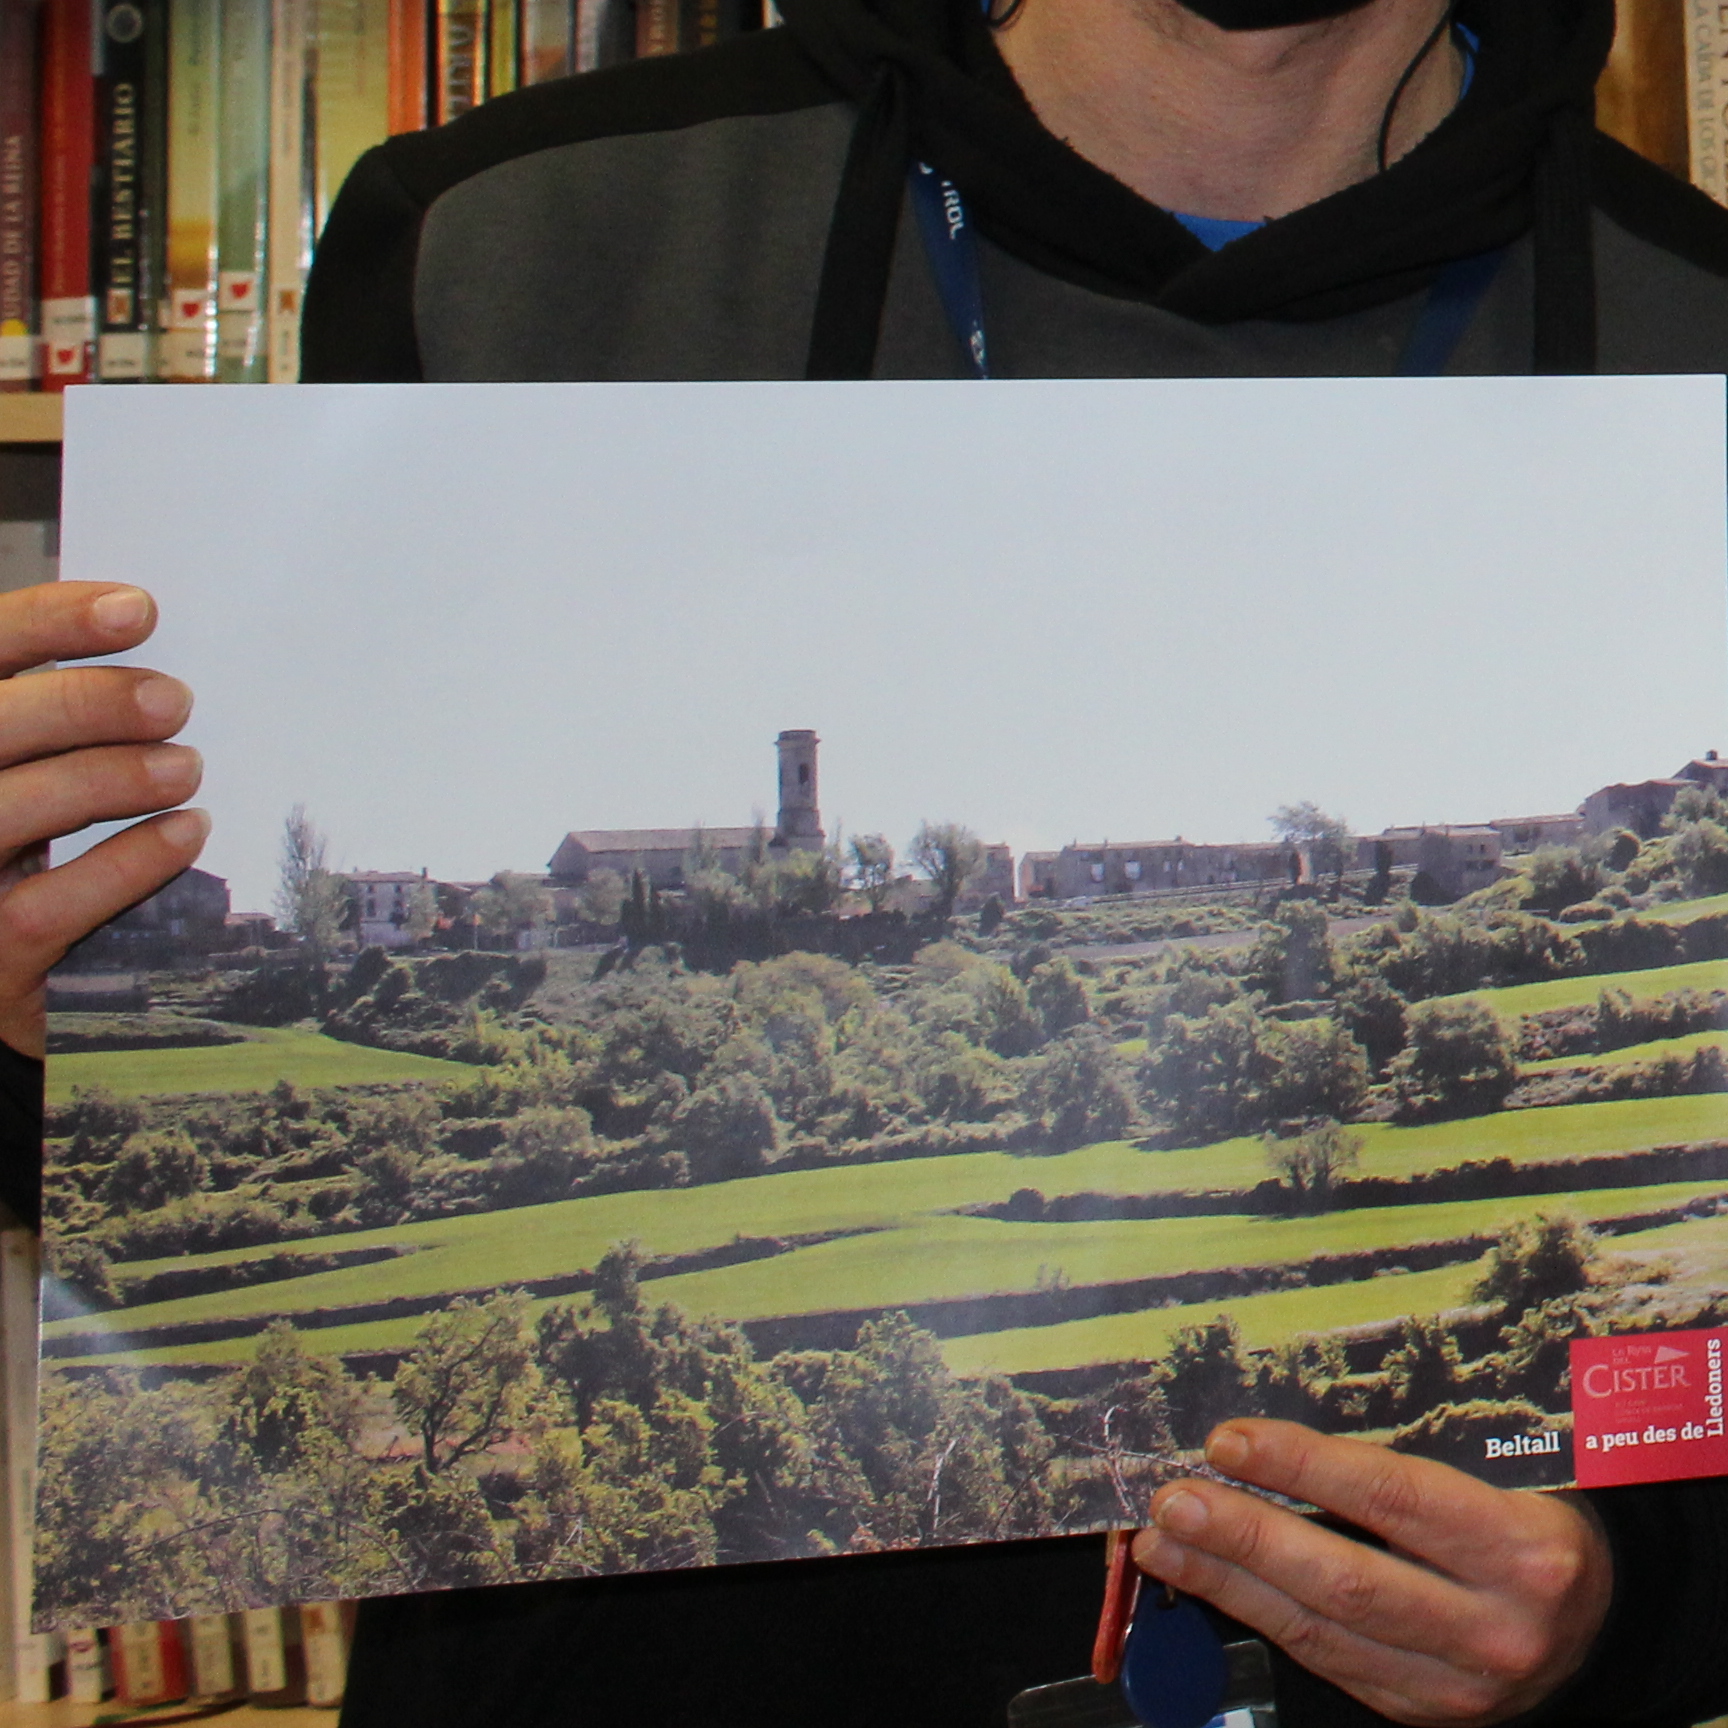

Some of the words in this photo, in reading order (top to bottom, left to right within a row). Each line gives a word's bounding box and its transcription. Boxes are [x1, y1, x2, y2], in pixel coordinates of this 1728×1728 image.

[110, 82, 137, 240] BESTIARIO
[1583, 1365, 1691, 1398] CISTER
[1706, 1339, 1724, 1437] Lledoners
[1485, 1432, 1560, 1459] Beltall
[1586, 1435, 1597, 1449] a
[1602, 1433, 1638, 1452] peu
[1643, 1427, 1676, 1445] des
[1681, 1422, 1704, 1440] de
